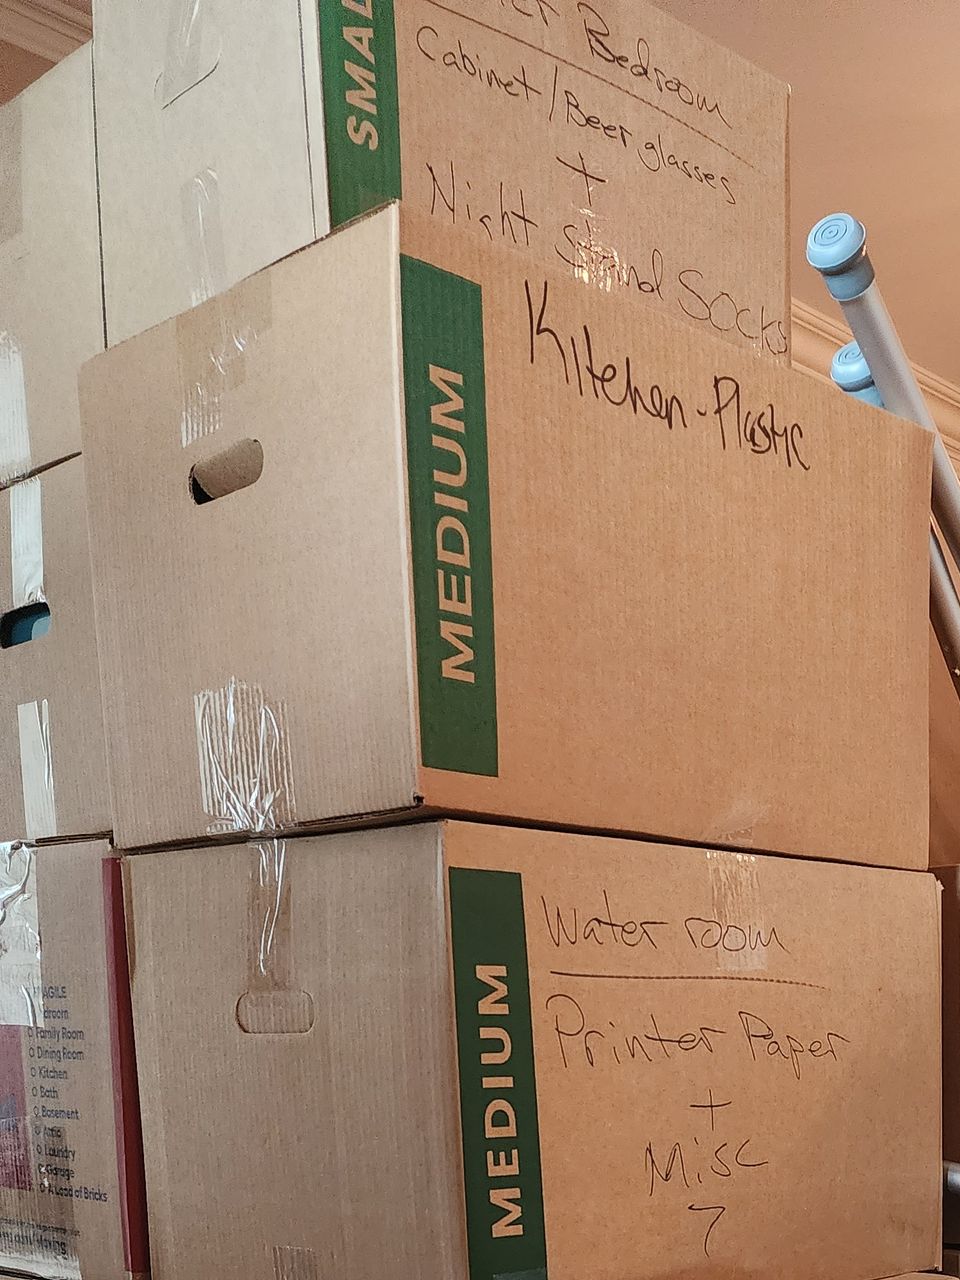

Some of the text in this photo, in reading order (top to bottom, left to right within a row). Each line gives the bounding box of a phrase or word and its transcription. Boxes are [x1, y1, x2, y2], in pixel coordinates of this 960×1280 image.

[577, 2, 732, 129] Bedroom
[638, 140, 736, 204] glasses
[426, 161, 538, 246] Night
[429, 363, 476, 684] MEDIUM
[541, 889, 790, 954] Water room
[36, 1027, 85, 1041] Family Room
[37, 1046, 85, 1062] Dining Room
[546, 994, 850, 1079] Printer Paper
[39, 1066, 68, 1079] Kitchen
[40, 1086, 59, 1099] Bath
[475, 964, 524, 1239] MEDIUM
[41, 1106, 80, 1120] Basement
[44, 1145, 76, 1162] Laundry
[645, 1138, 769, 1196] Misc
[84, 1187, 108, 1203] Bricks
